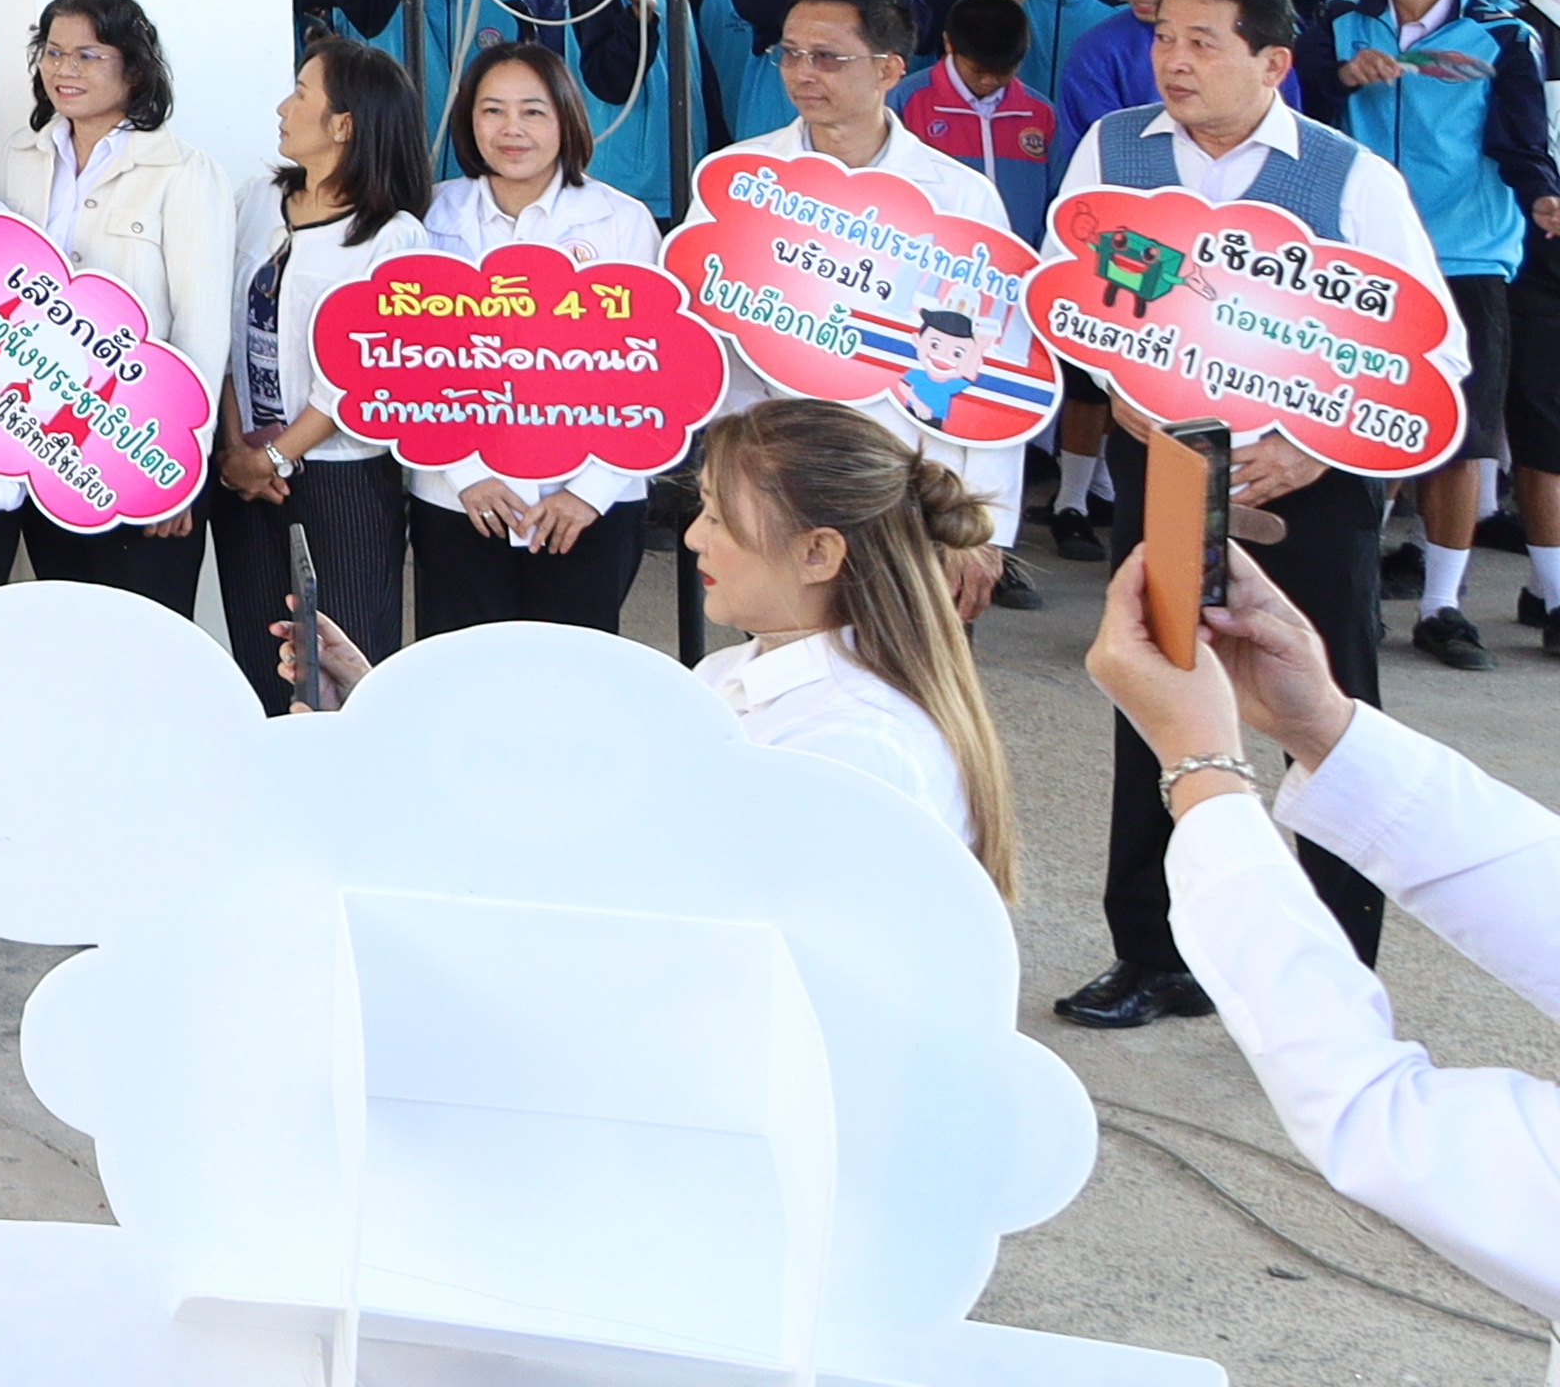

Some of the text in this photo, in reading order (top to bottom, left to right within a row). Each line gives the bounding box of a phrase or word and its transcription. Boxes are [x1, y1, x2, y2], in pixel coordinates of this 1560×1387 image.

[730, 169, 1020, 306] สร้างสรรค์ประเทศไทย
[774, 235, 893, 301] พร้อมใจ
[1197, 232, 1393, 318] เช็คให้ดี
[7, 267, 143, 382] เลือกตั้ง
[377, 274, 634, 319] เลือกตั้ง 4 ปี
[699, 254, 861, 359] ไปเลือกตั้ง
[349, 331, 660, 373] โปรดเลือกคนดี
[1051, 303, 1425, 451] วันเสาร์ที่ 1 กุมภาพันธ์ 2568
[1216, 299, 1406, 384] ก่อนเข้าคูหา
[358, 380, 664, 429] ทำหน้าที่แทนเรา
